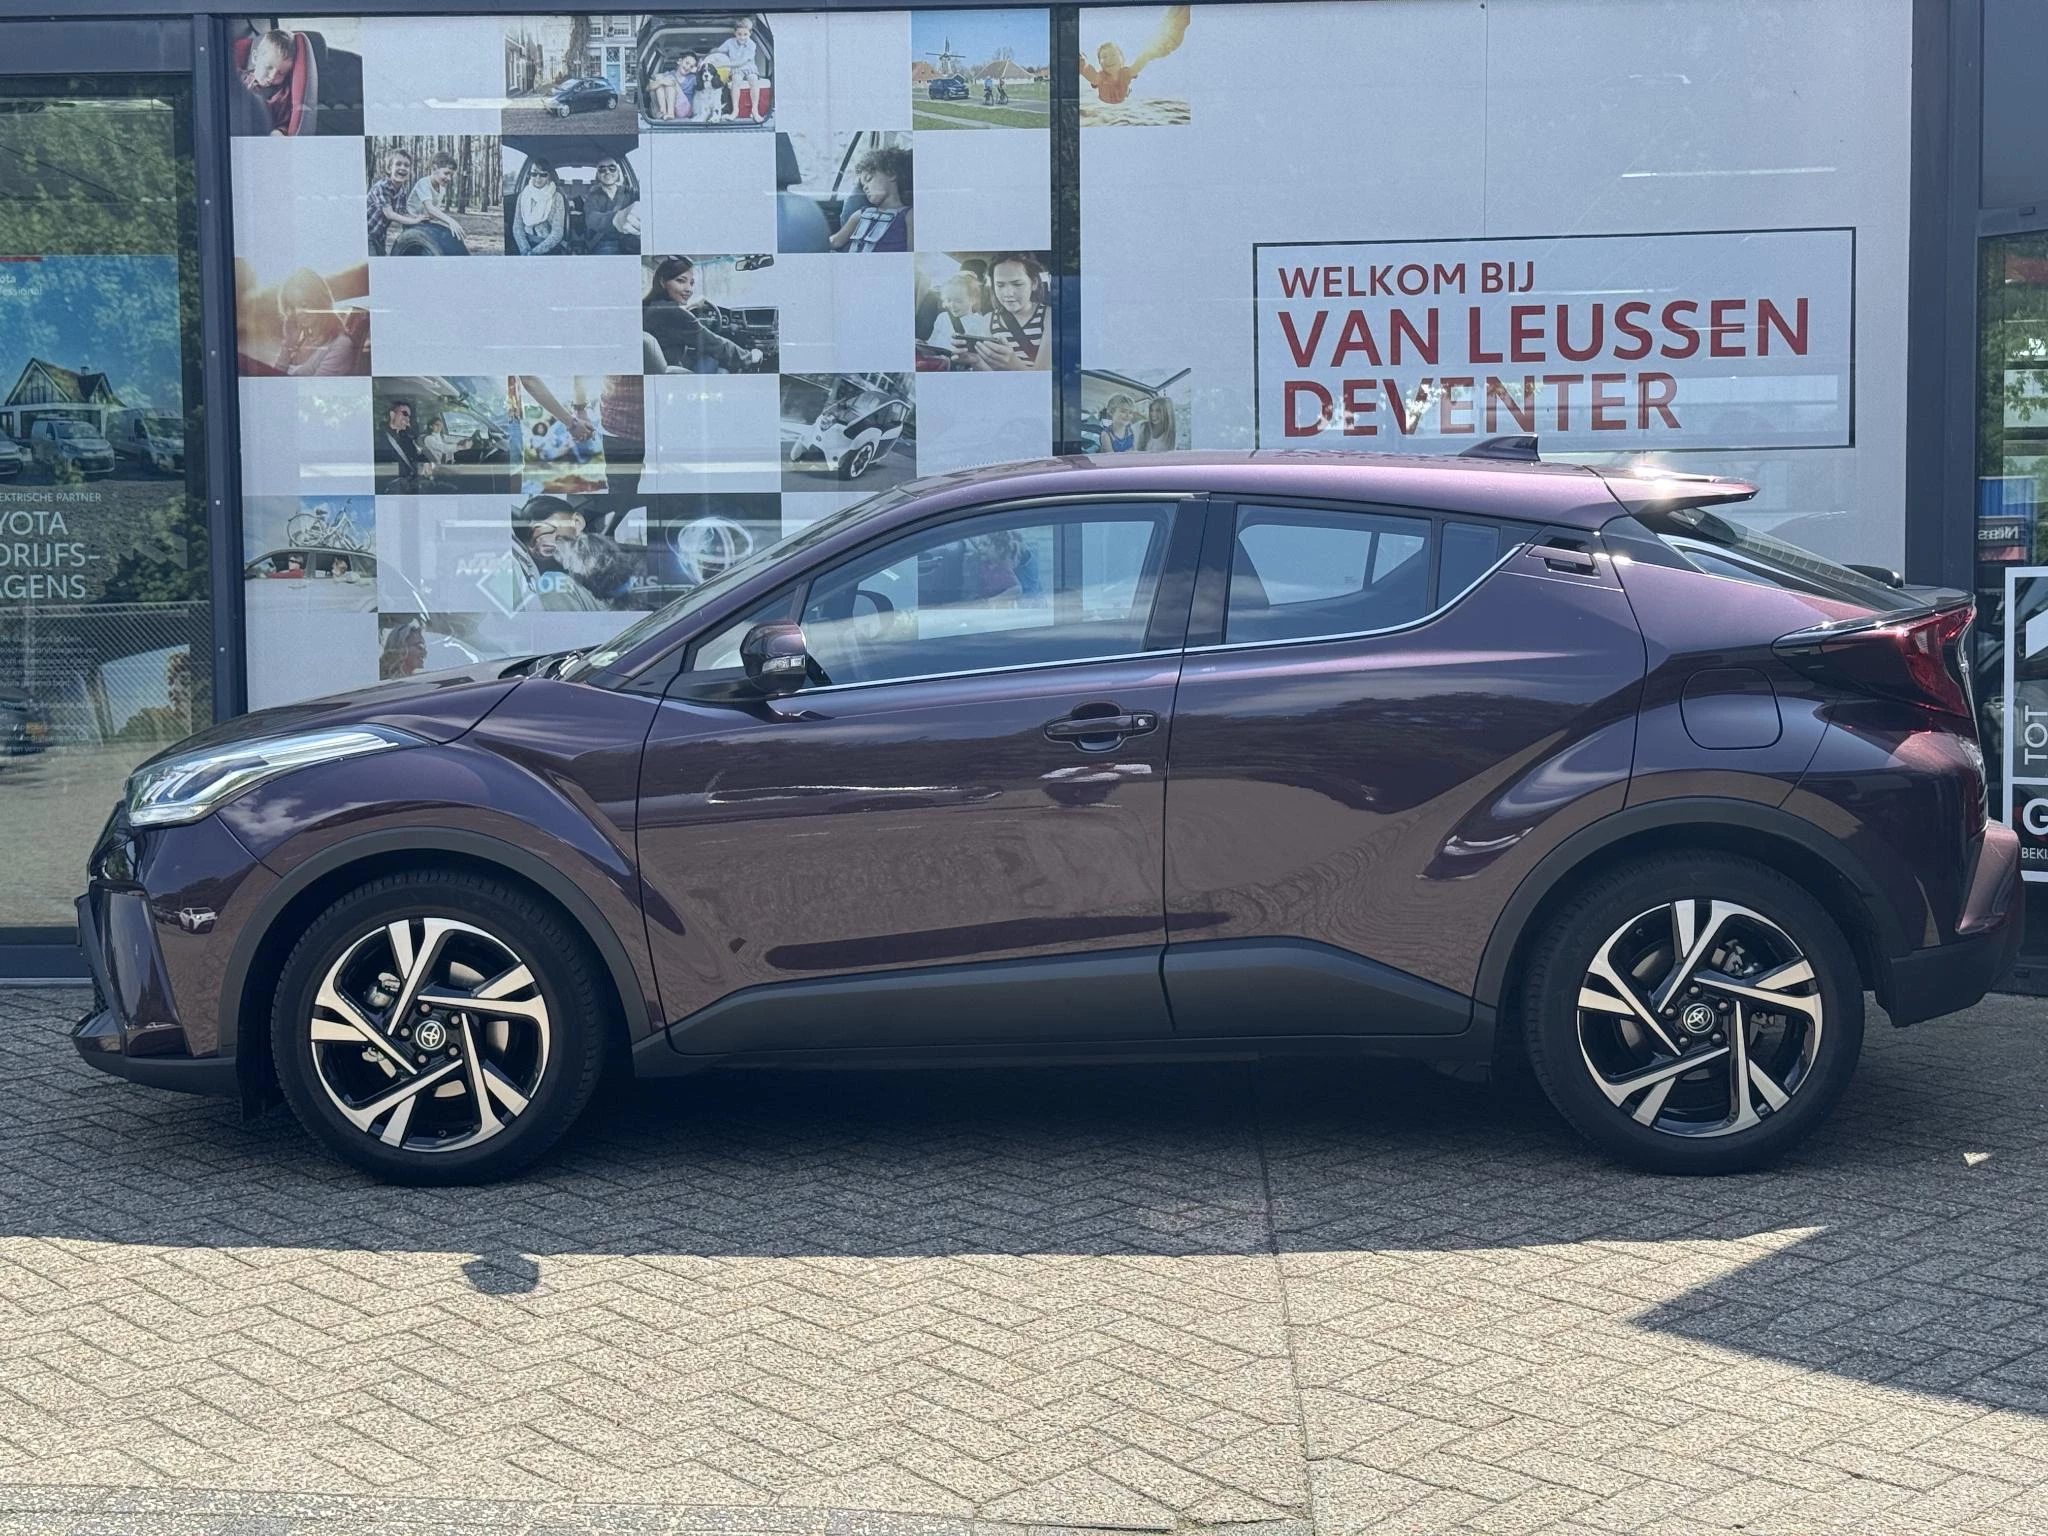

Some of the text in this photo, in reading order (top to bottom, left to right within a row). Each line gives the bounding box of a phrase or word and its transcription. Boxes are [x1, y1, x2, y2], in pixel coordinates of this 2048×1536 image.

[1278, 260, 1535, 298] WELKOM BIJ
[1278, 297, 1810, 368] VAN LEUSSEN
[1284, 371, 1682, 438] DEVENTER
[56, 492, 102, 502] PARTNER
[0, 511, 69, 536] YOTA
[0, 574, 86, 600] GENS
[2024, 705, 2048, 765] TOT
[2021, 847, 2048, 860] BEKI
